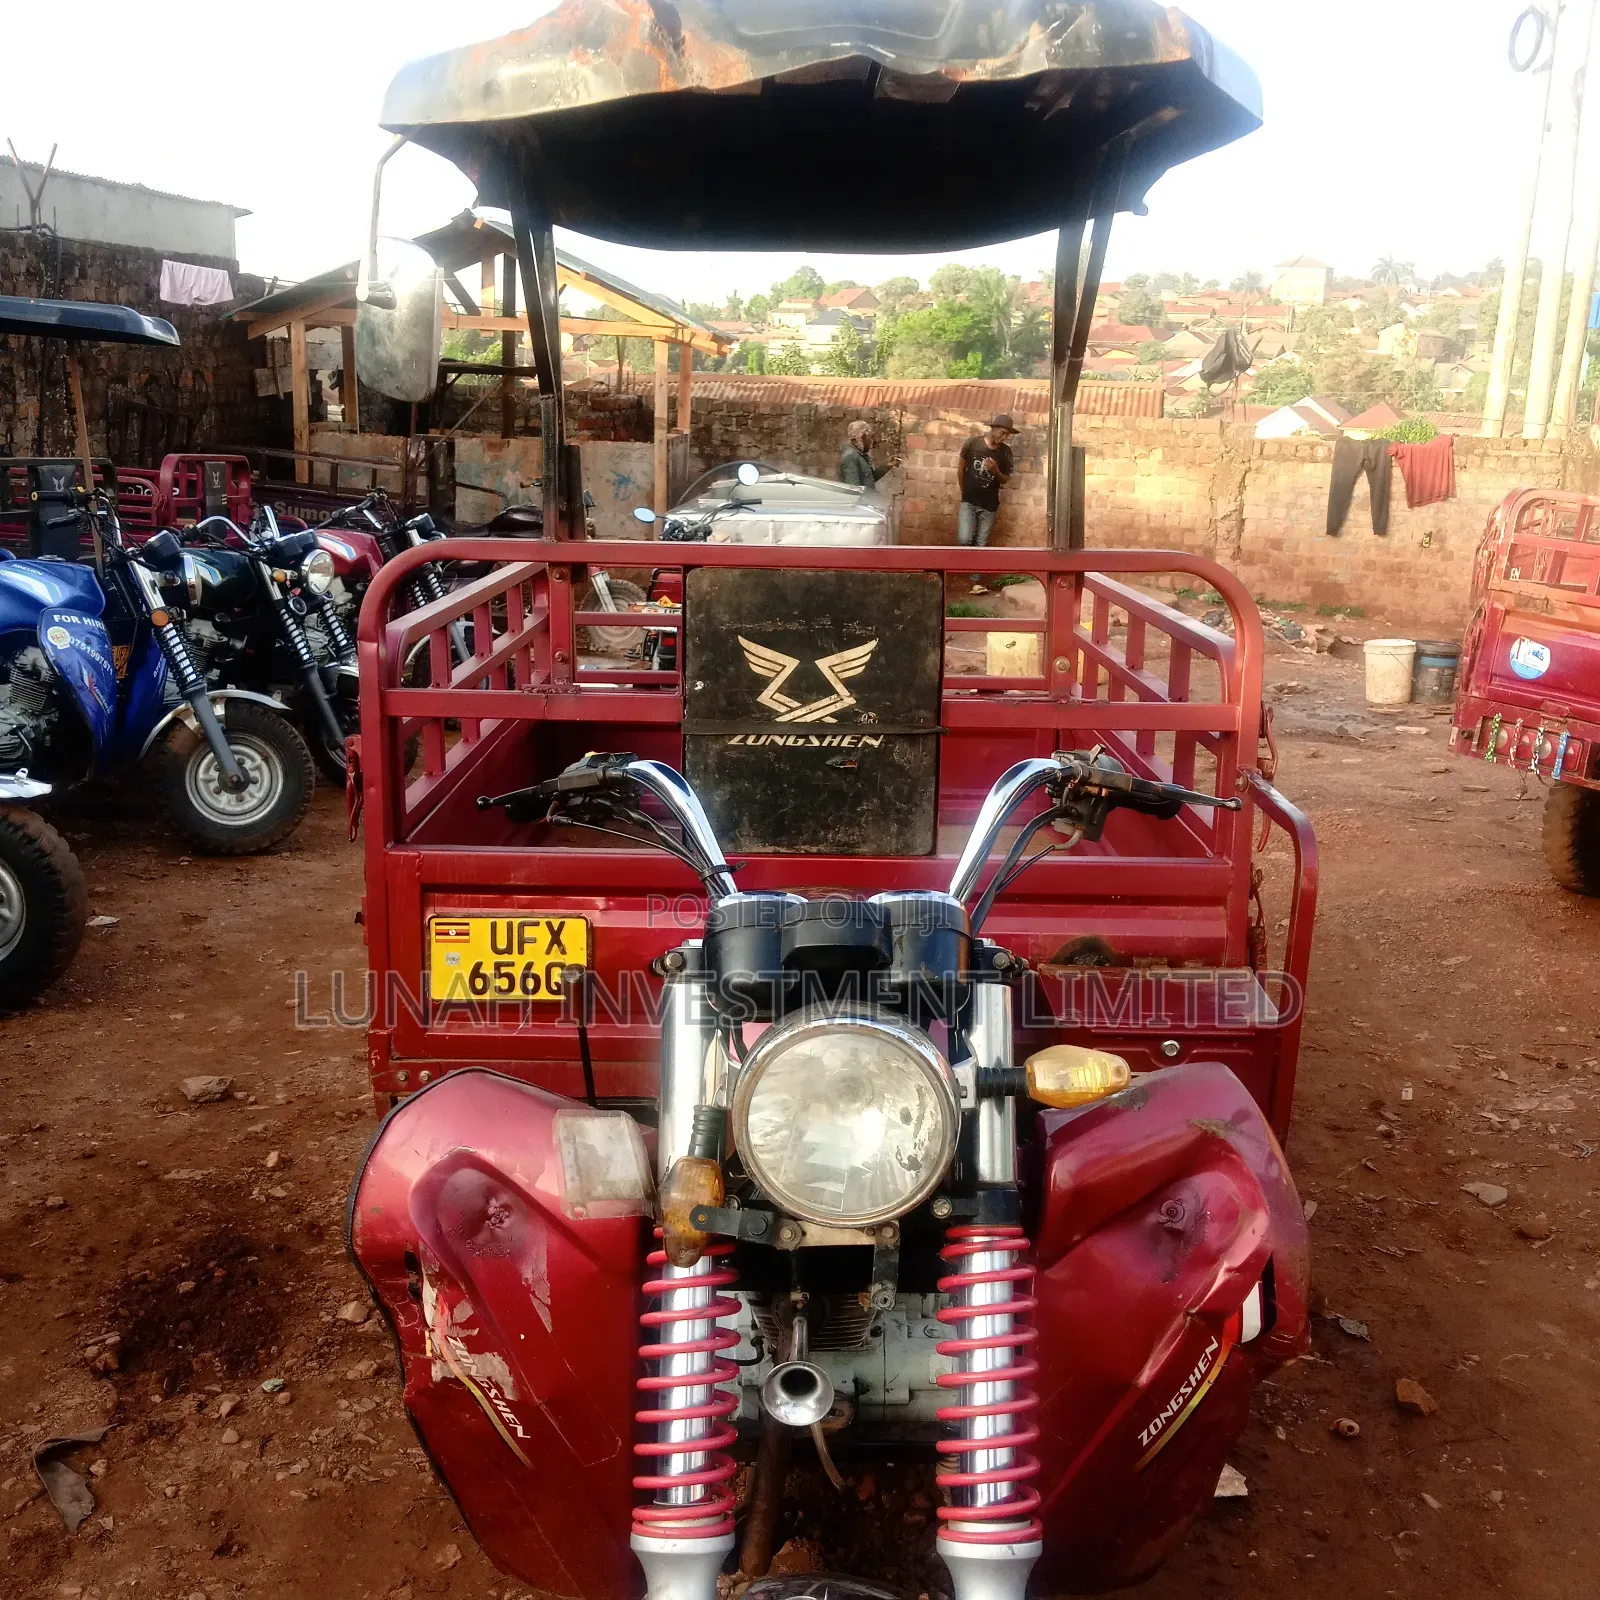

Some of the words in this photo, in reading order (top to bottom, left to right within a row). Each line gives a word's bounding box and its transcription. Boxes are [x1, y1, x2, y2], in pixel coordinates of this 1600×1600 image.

[53, 614, 81, 624] FOR
[490, 920, 567, 955] UFX
[446, 1336, 531, 1439] ZONGSHEN
[1137, 1335, 1219, 1447] ZONGSHEN
